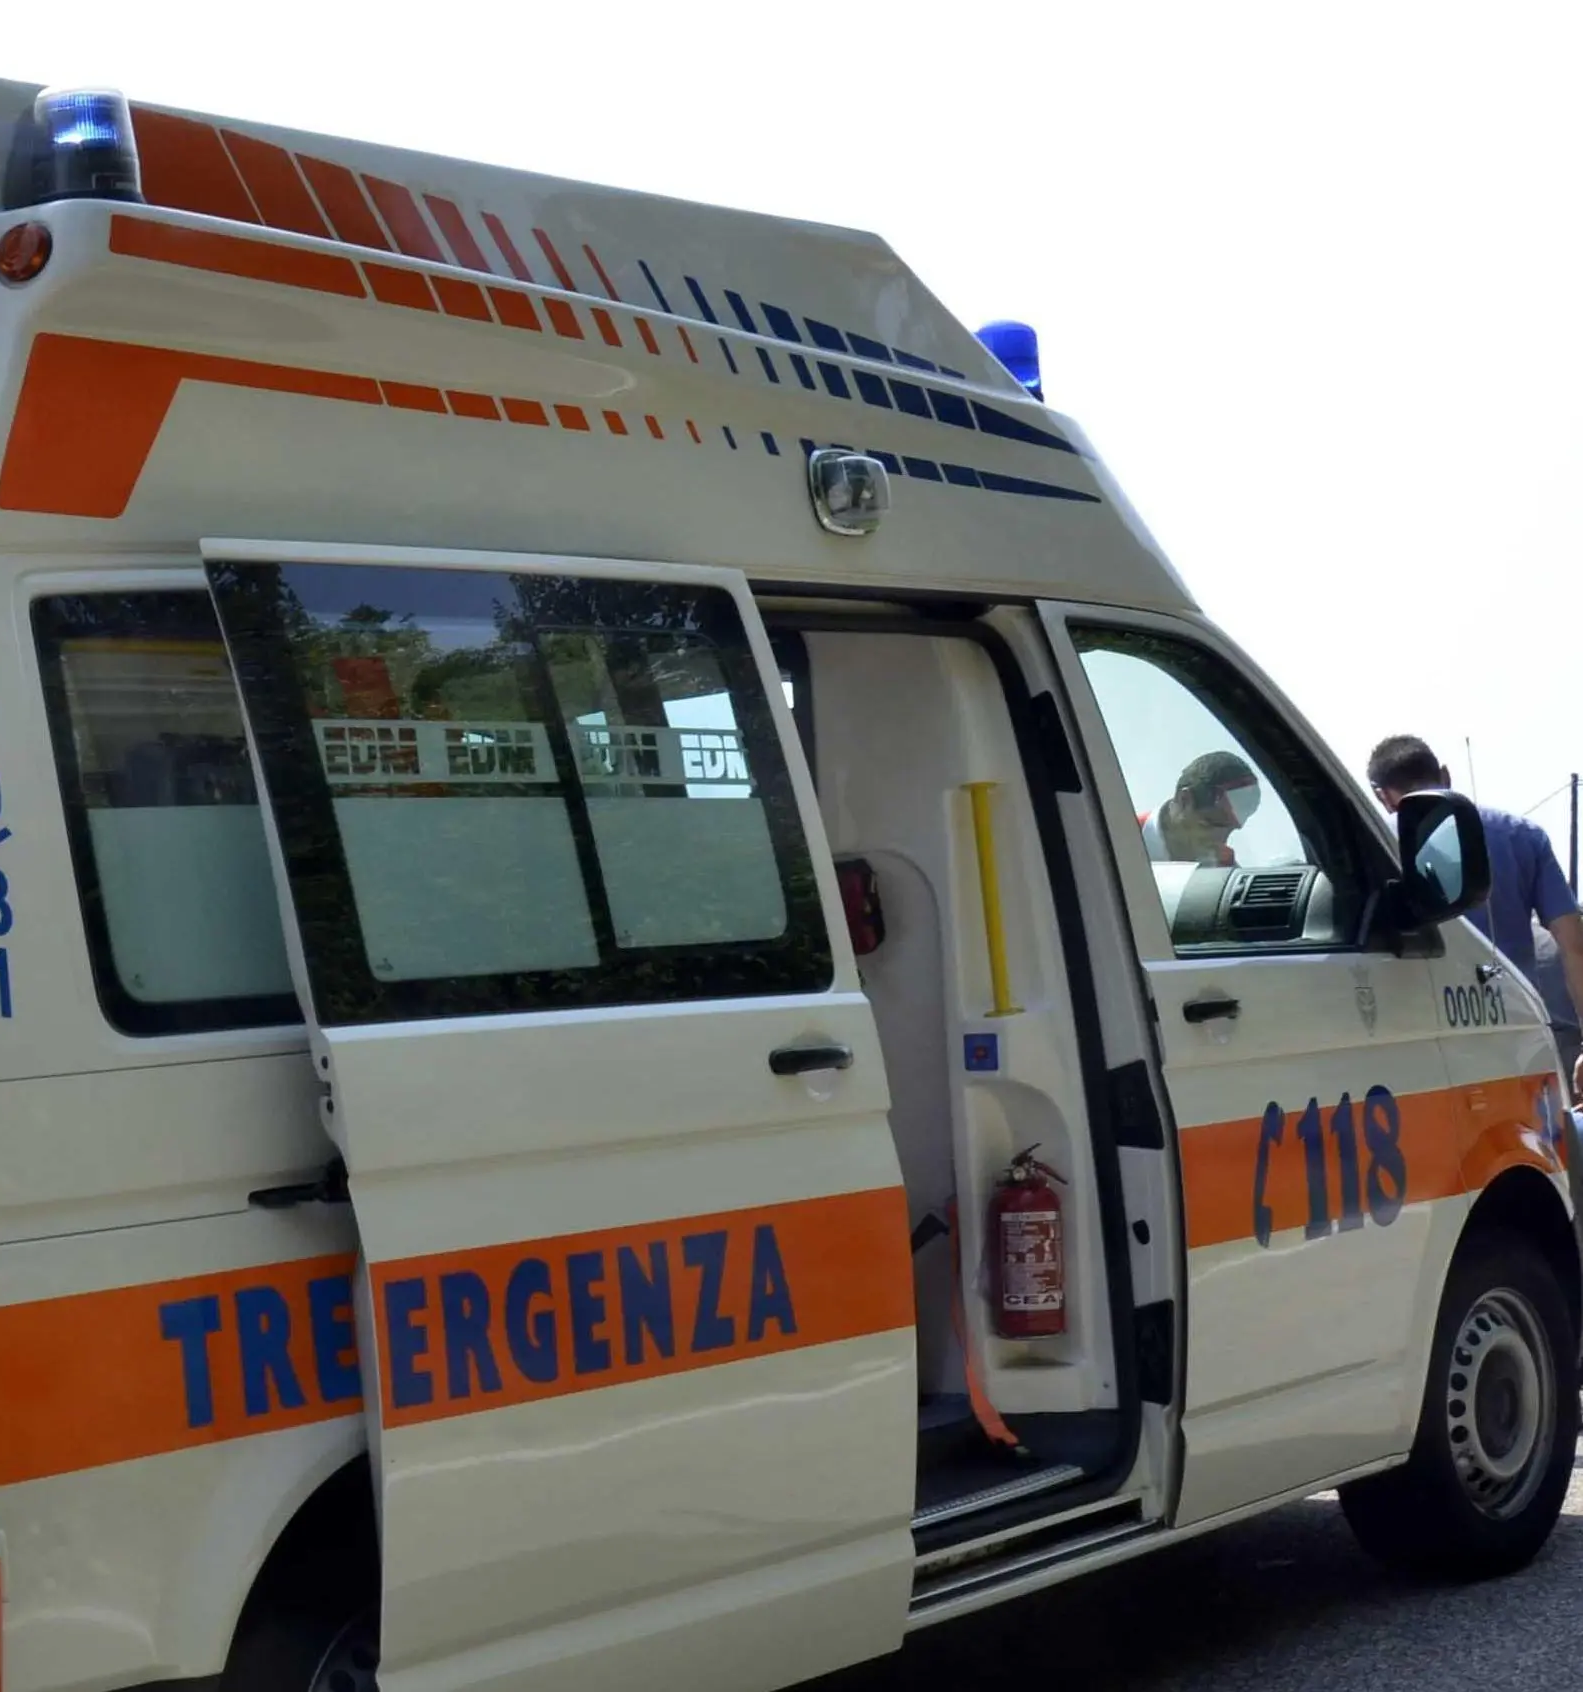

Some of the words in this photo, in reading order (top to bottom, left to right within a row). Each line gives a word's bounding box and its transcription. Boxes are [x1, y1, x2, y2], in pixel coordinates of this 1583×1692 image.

[1444, 985, 1508, 1028] 000/31
[1297, 1085, 1407, 1241] 118
[158, 1275, 364, 1429] TRE
[383, 1224, 797, 1410] ERGENZA
